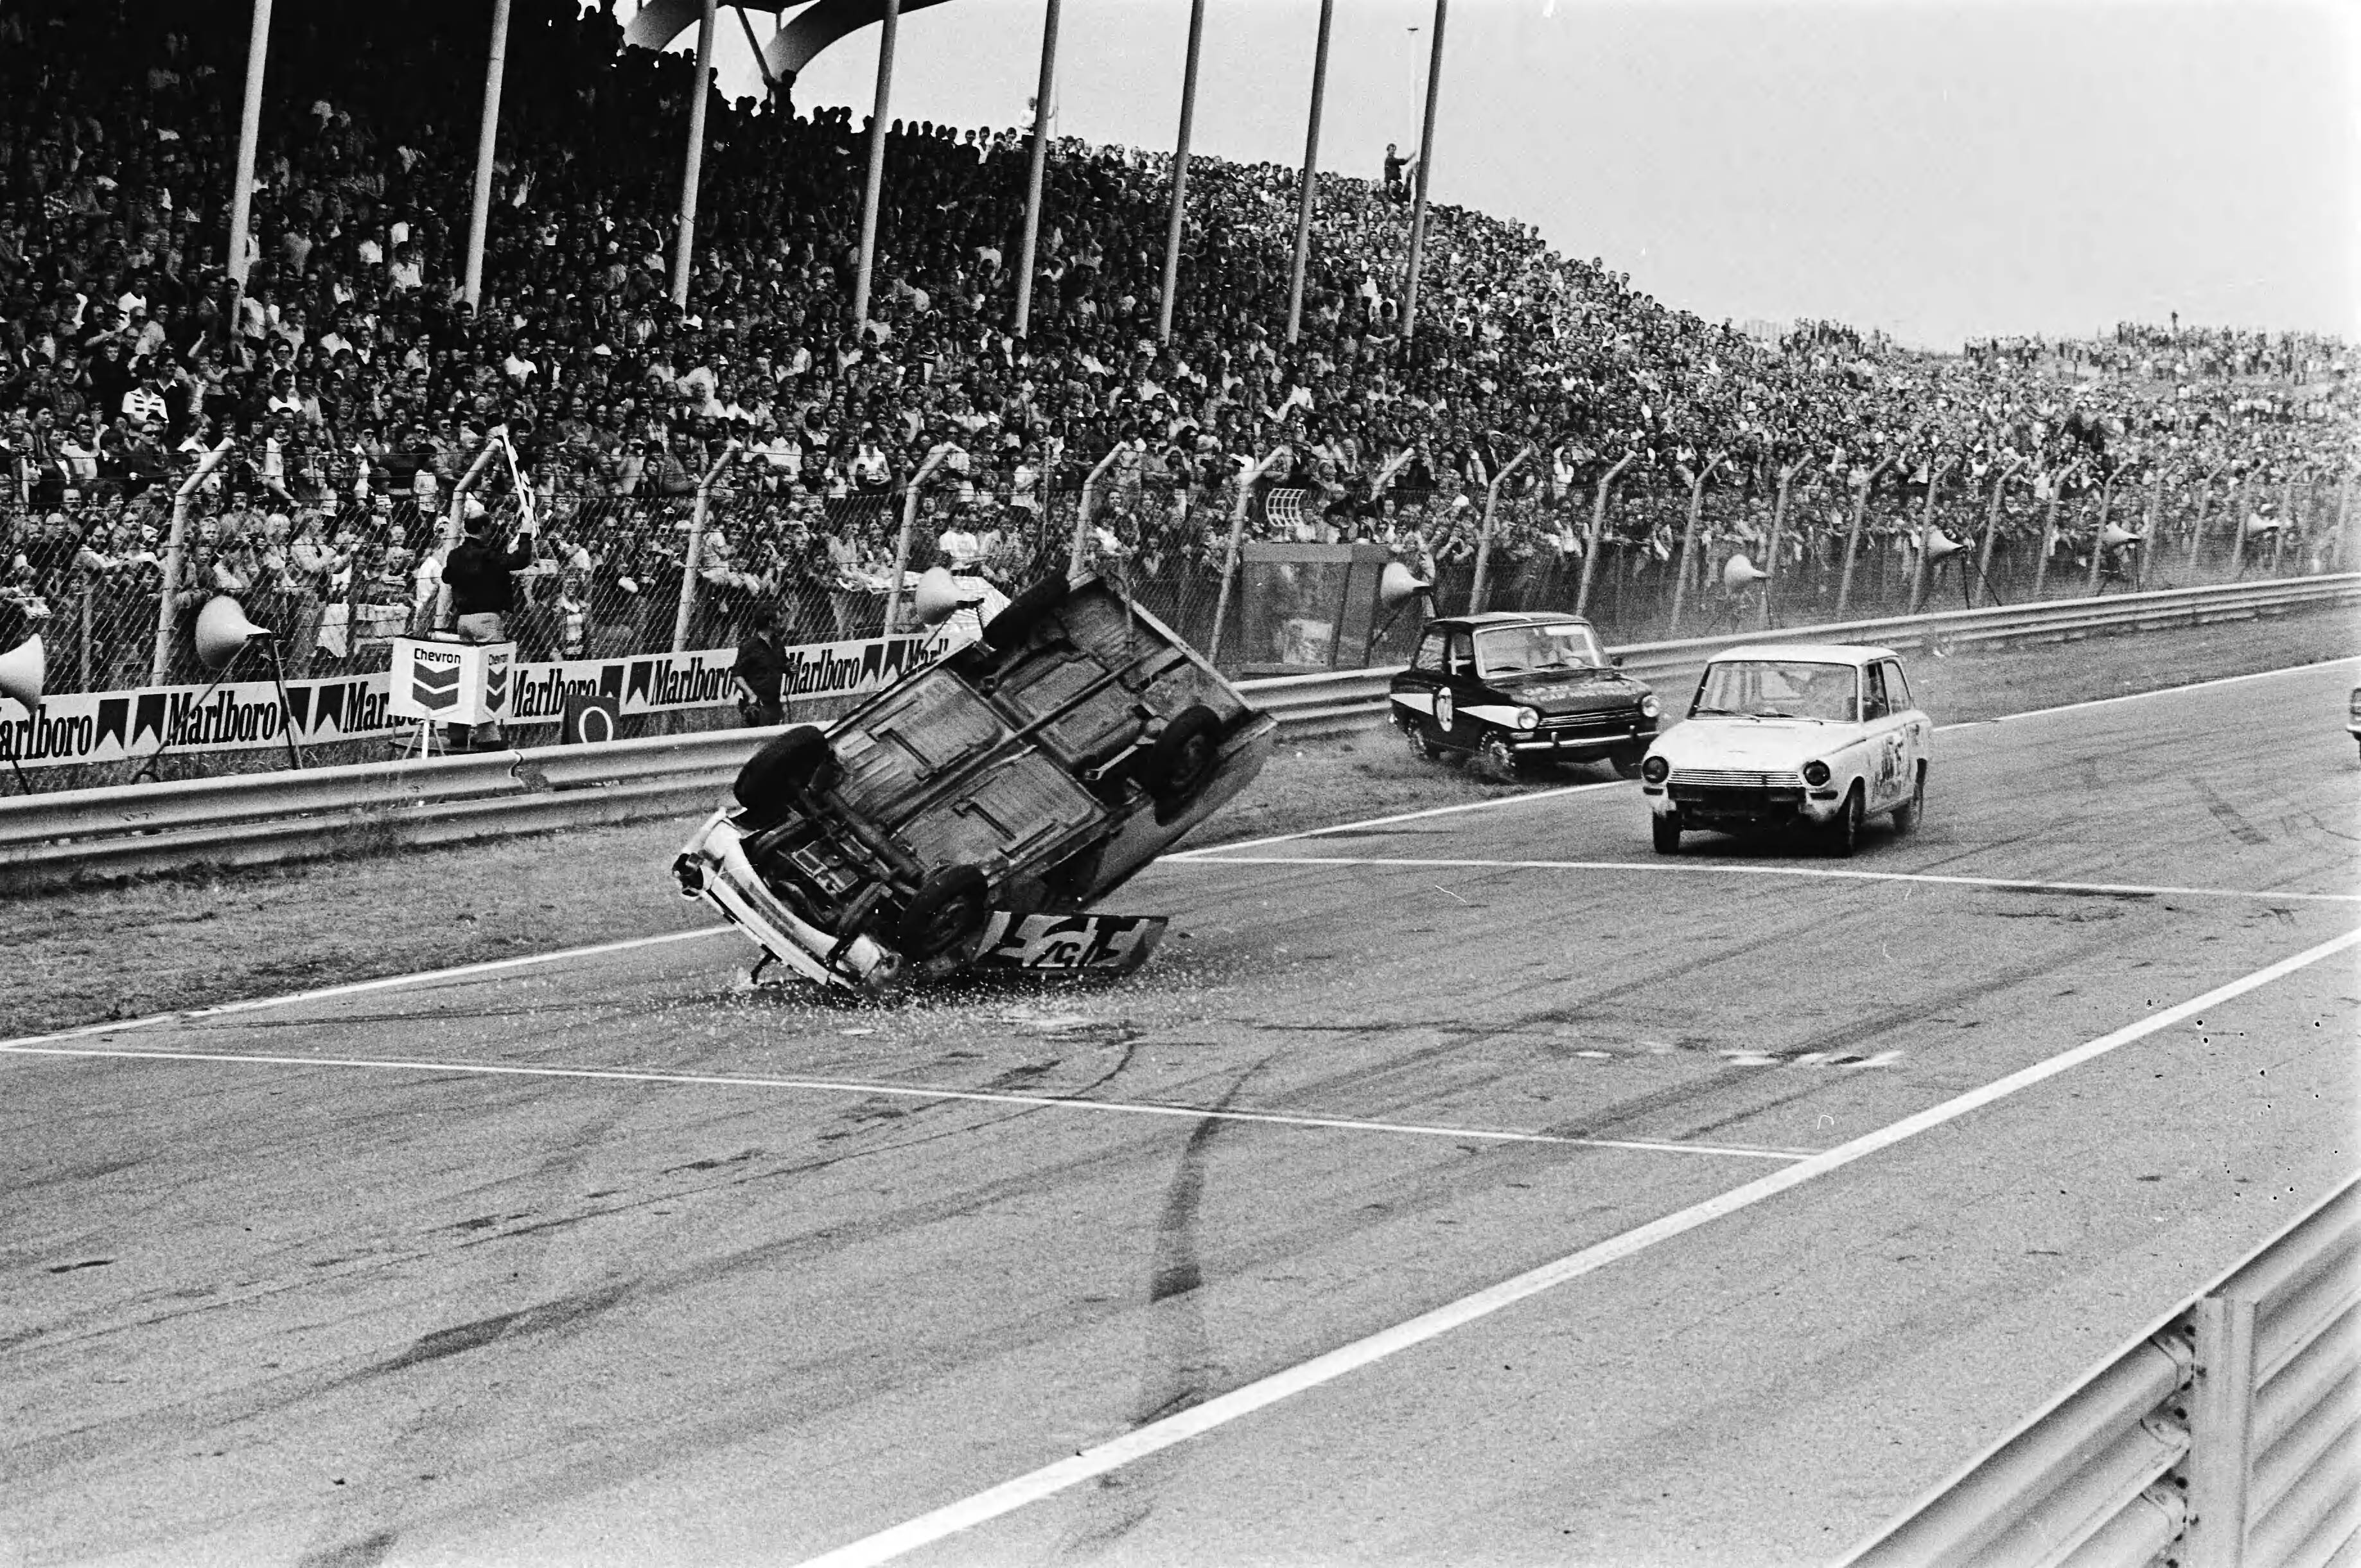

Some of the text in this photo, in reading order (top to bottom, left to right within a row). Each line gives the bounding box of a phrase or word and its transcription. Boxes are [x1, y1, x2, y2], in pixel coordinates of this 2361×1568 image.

[414, 647, 461, 664] Chevron
[782, 649, 860, 695] Marlboro
[649, 657, 734, 706] Marlboro
[0, 704, 92, 761] arlboro
[163, 690, 277, 747] Marlboro
